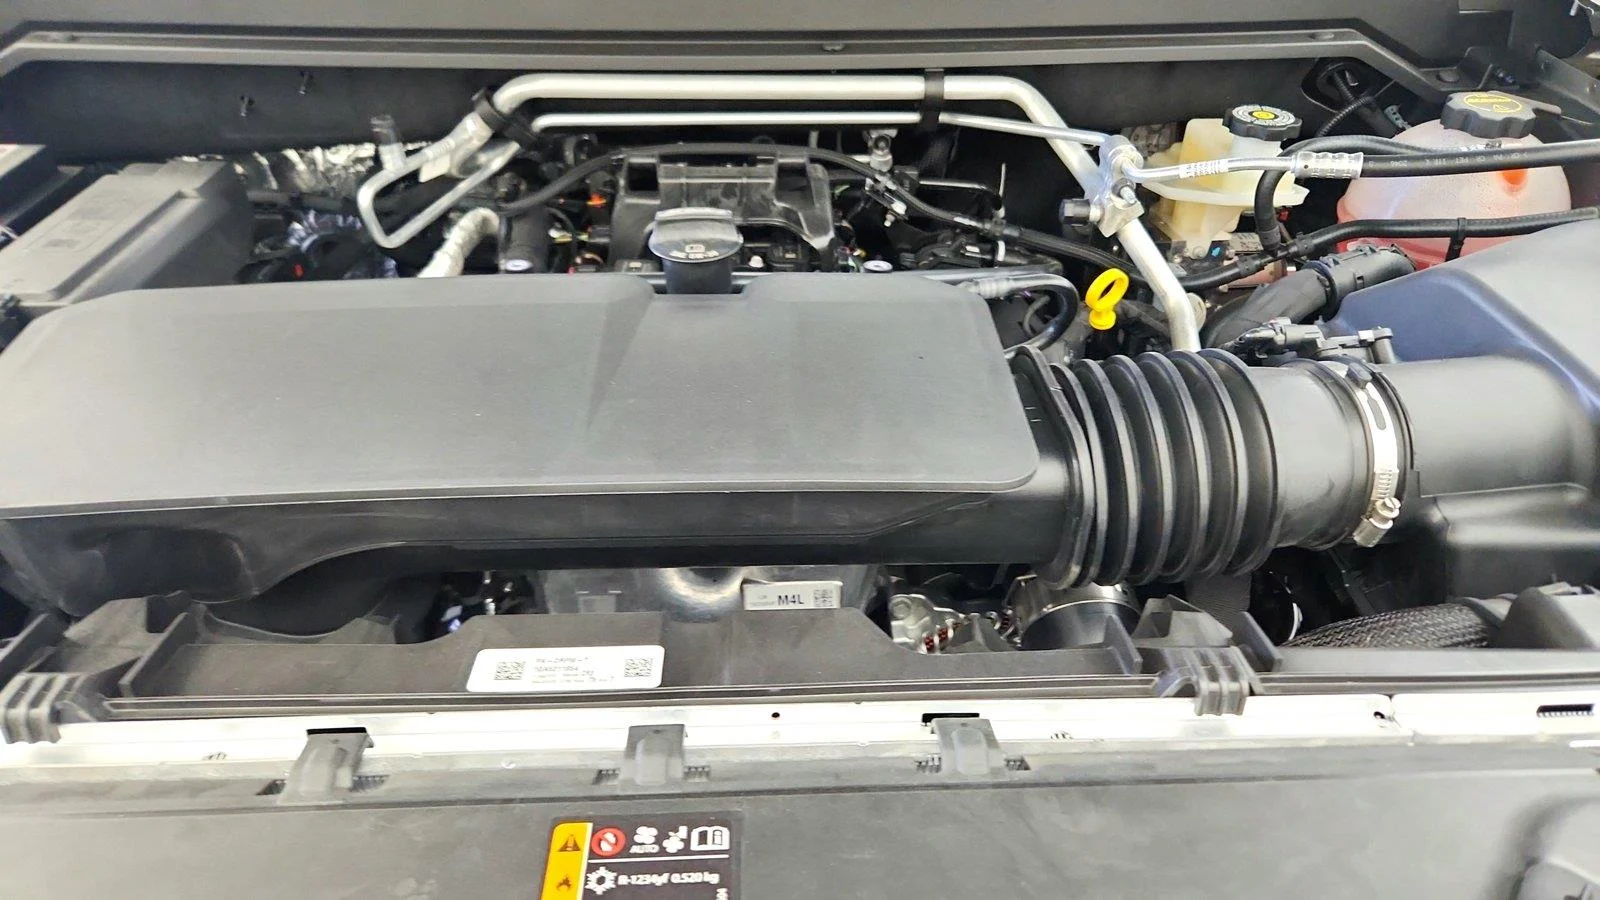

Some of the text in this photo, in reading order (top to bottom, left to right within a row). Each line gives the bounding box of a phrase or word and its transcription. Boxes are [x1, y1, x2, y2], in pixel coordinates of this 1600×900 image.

[777, 594, 804, 605] M4L
[617, 871, 720, 886] R-1234yf 0.520 kg
